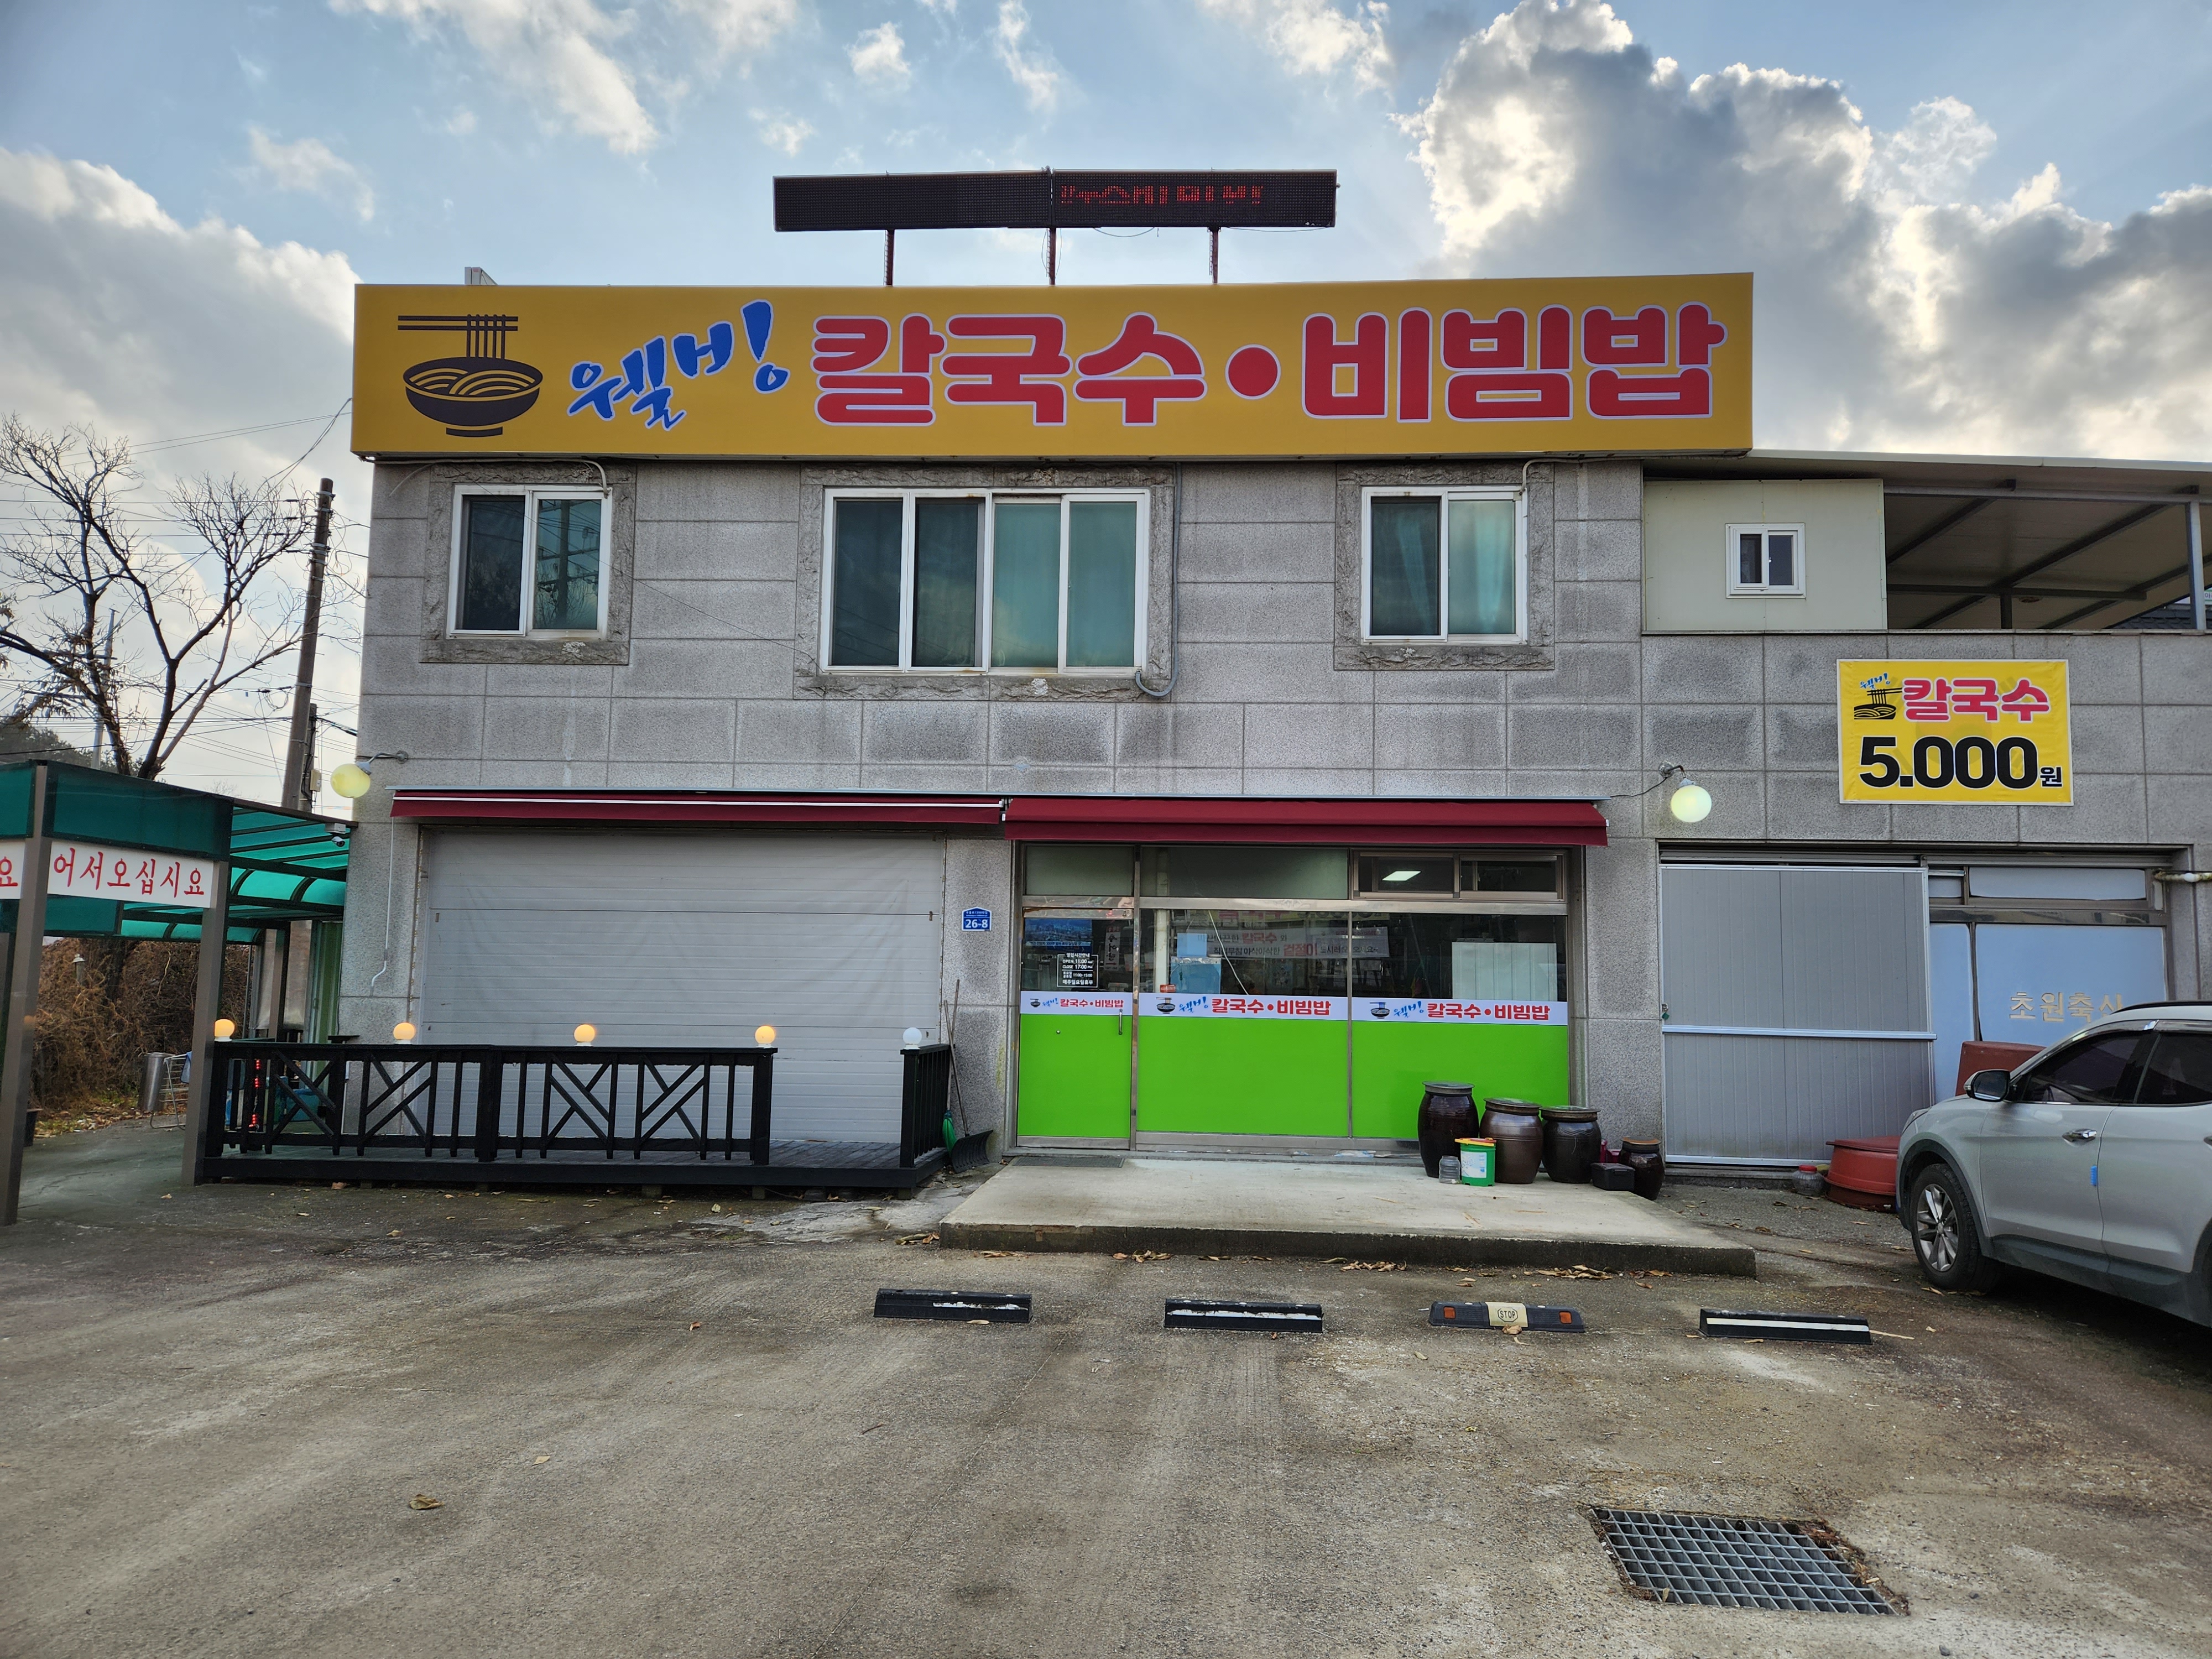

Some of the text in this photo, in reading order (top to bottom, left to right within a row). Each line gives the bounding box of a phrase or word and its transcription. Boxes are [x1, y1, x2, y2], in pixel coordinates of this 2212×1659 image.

[1902, 677, 2051, 722] 칼국수
[54, 847, 205, 898] 어서오십시요
[965, 919, 988, 928] 26-8
[1500, 1310, 1515, 1318] STOP
